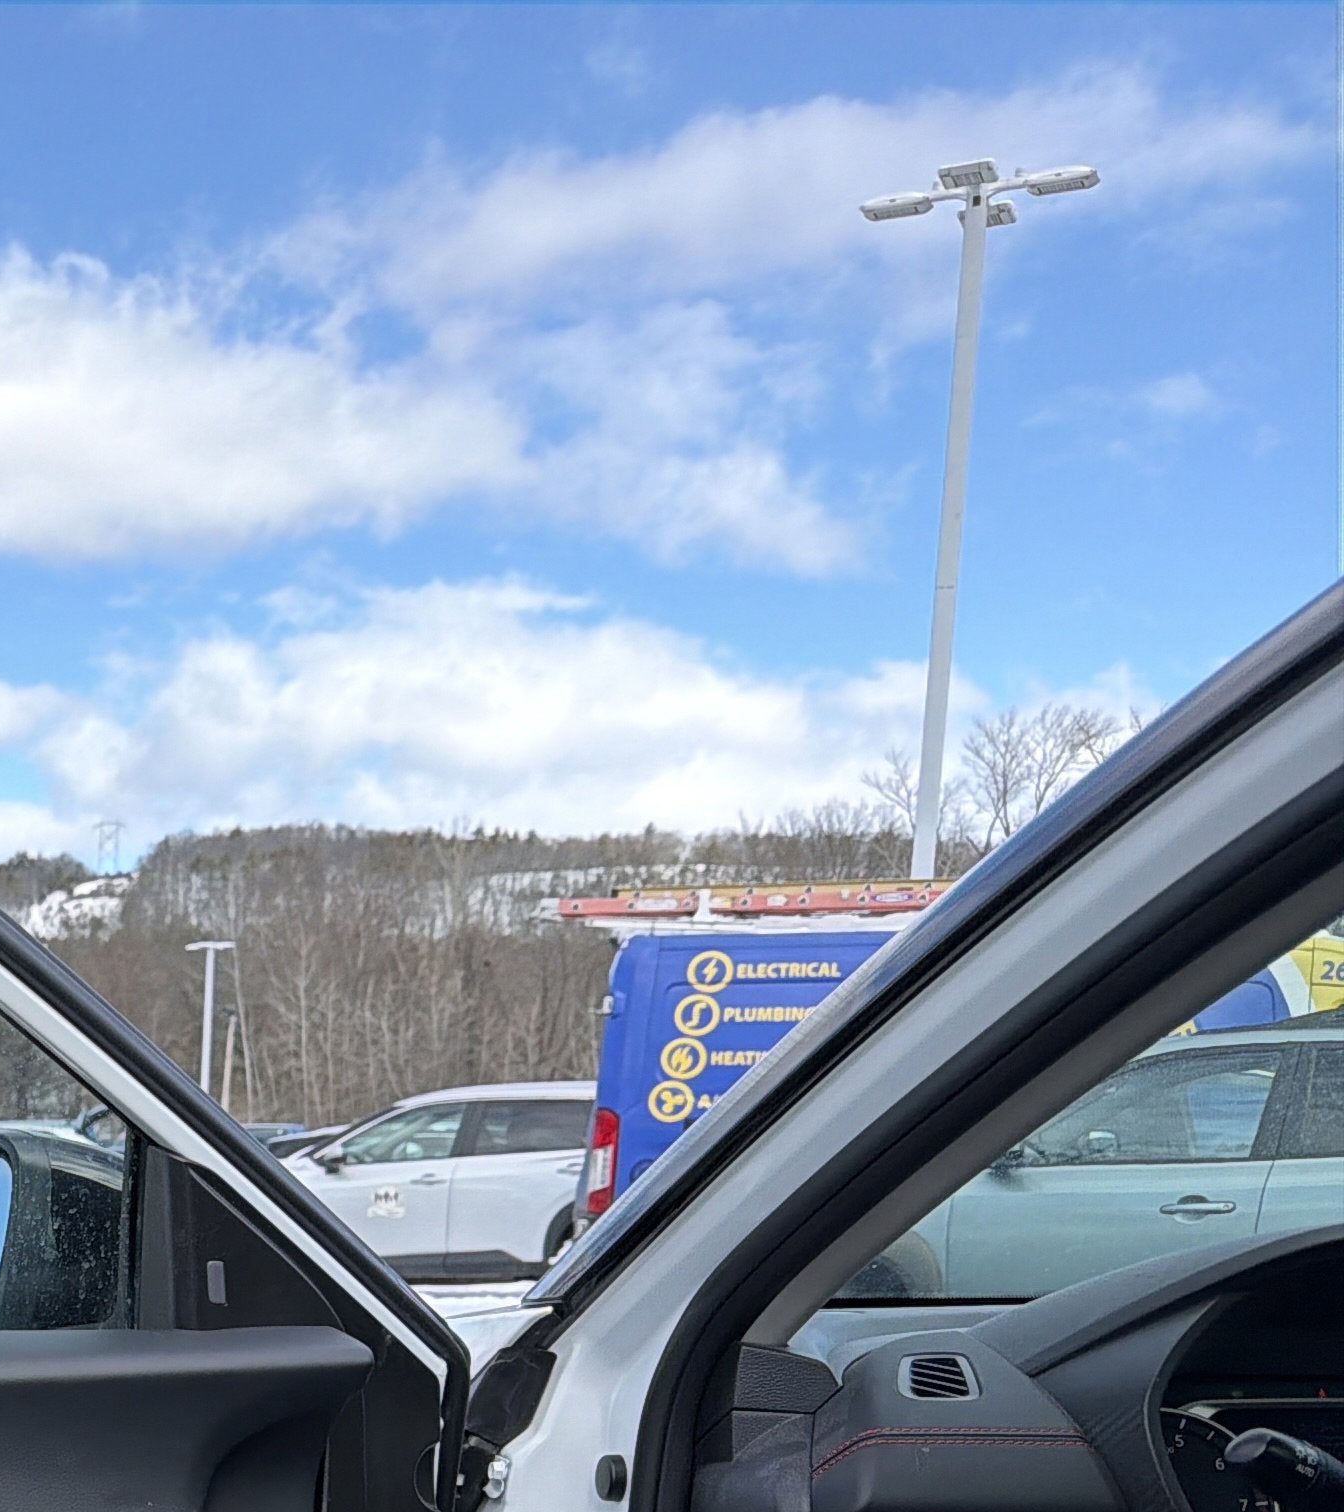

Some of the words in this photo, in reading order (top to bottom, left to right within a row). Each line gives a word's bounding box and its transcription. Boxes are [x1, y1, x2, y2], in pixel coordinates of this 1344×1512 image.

[736, 962, 841, 979] ELECTRICAL
[1174, 1434, 1185, 1448] 5
[1215, 1457, 1225, 1471] 6
[1295, 1464, 1315, 1478] AUTO
[1238, 1498, 1248, 1512] 7
